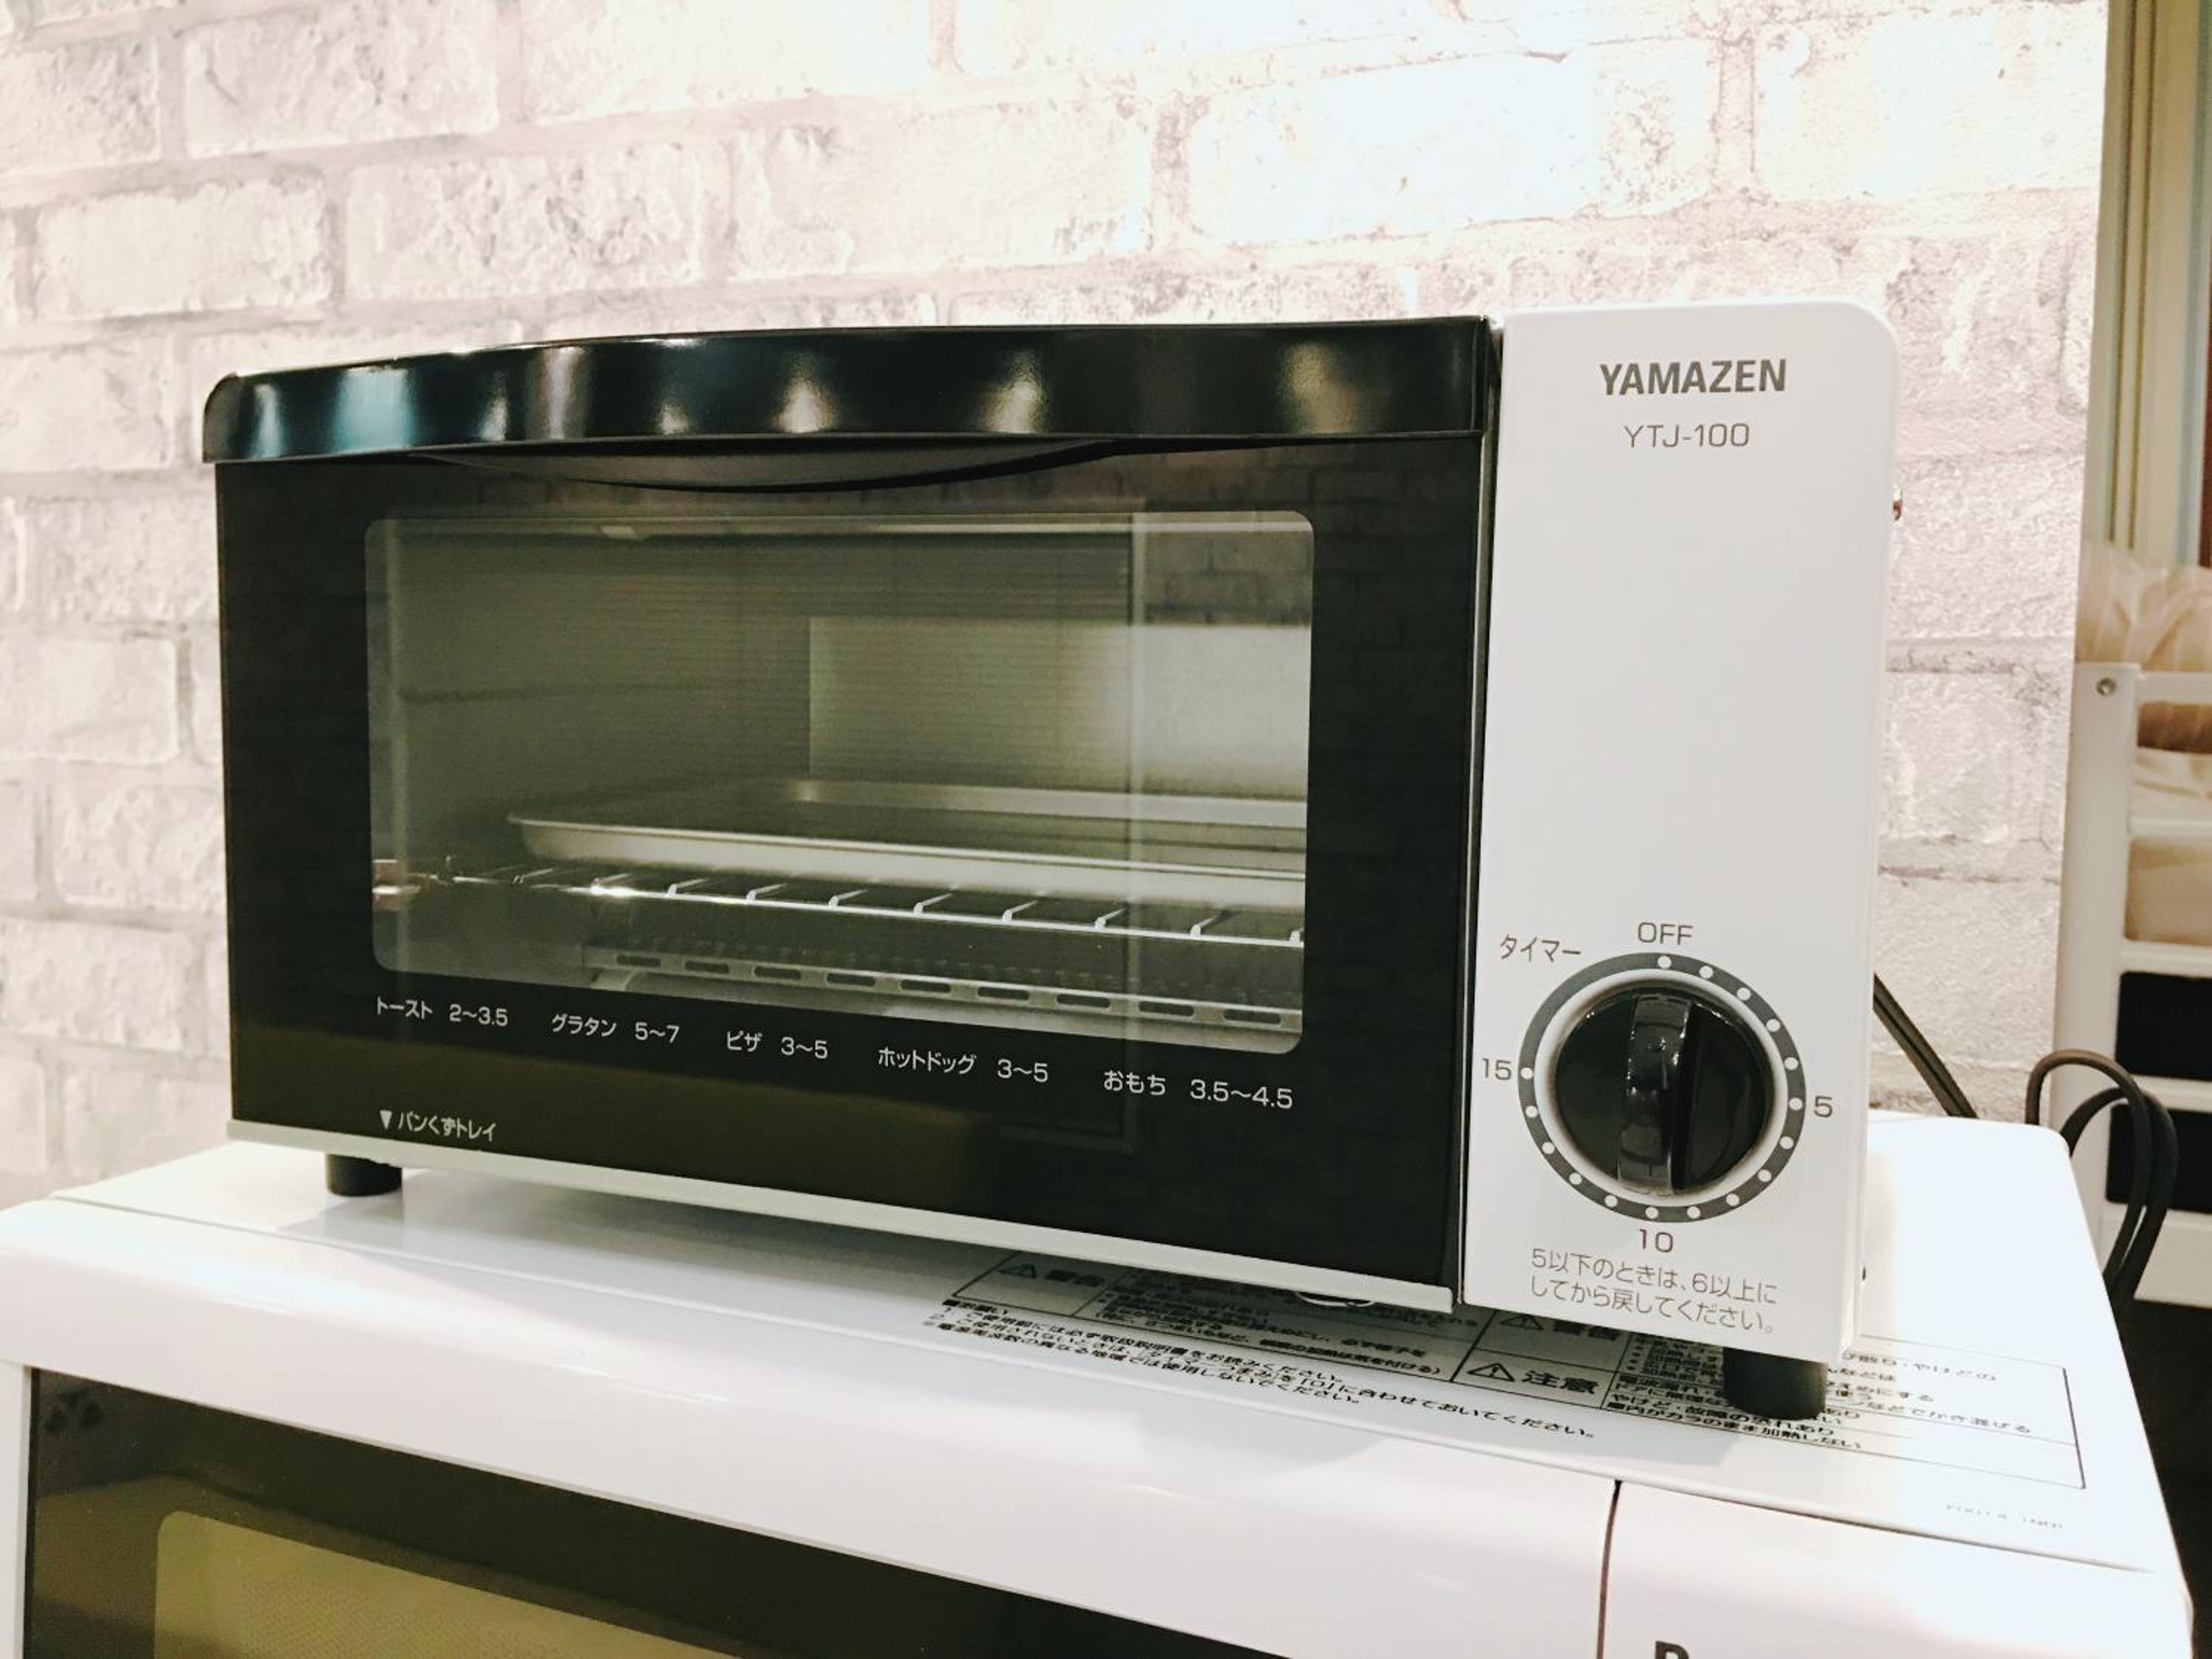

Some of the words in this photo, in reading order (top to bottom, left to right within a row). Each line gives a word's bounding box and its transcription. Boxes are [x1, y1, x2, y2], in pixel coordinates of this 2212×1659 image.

[1599, 358, 1788, 396] YAMAZEN
[1624, 422, 1750, 448] YTJ-100
[1637, 922, 1694, 946] OFF
[1499, 934, 1582, 963] タイマー
[377, 996, 434, 1020] トースト
[552, 1012, 618, 1037] グラタン
[725, 1031, 763, 1053] ピザ
[877, 1046, 978, 1075] ホットドッグ
[1104, 1070, 1167, 1096] おもち
[1481, 1058, 1512, 1080] 15
[1813, 1096, 1834, 1118] 5
[1638, 1228, 1674, 1253] 10
[1530, 1274, 1773, 1334] してから戻してください。
[1521, 1369, 1600, 1395] 注意
